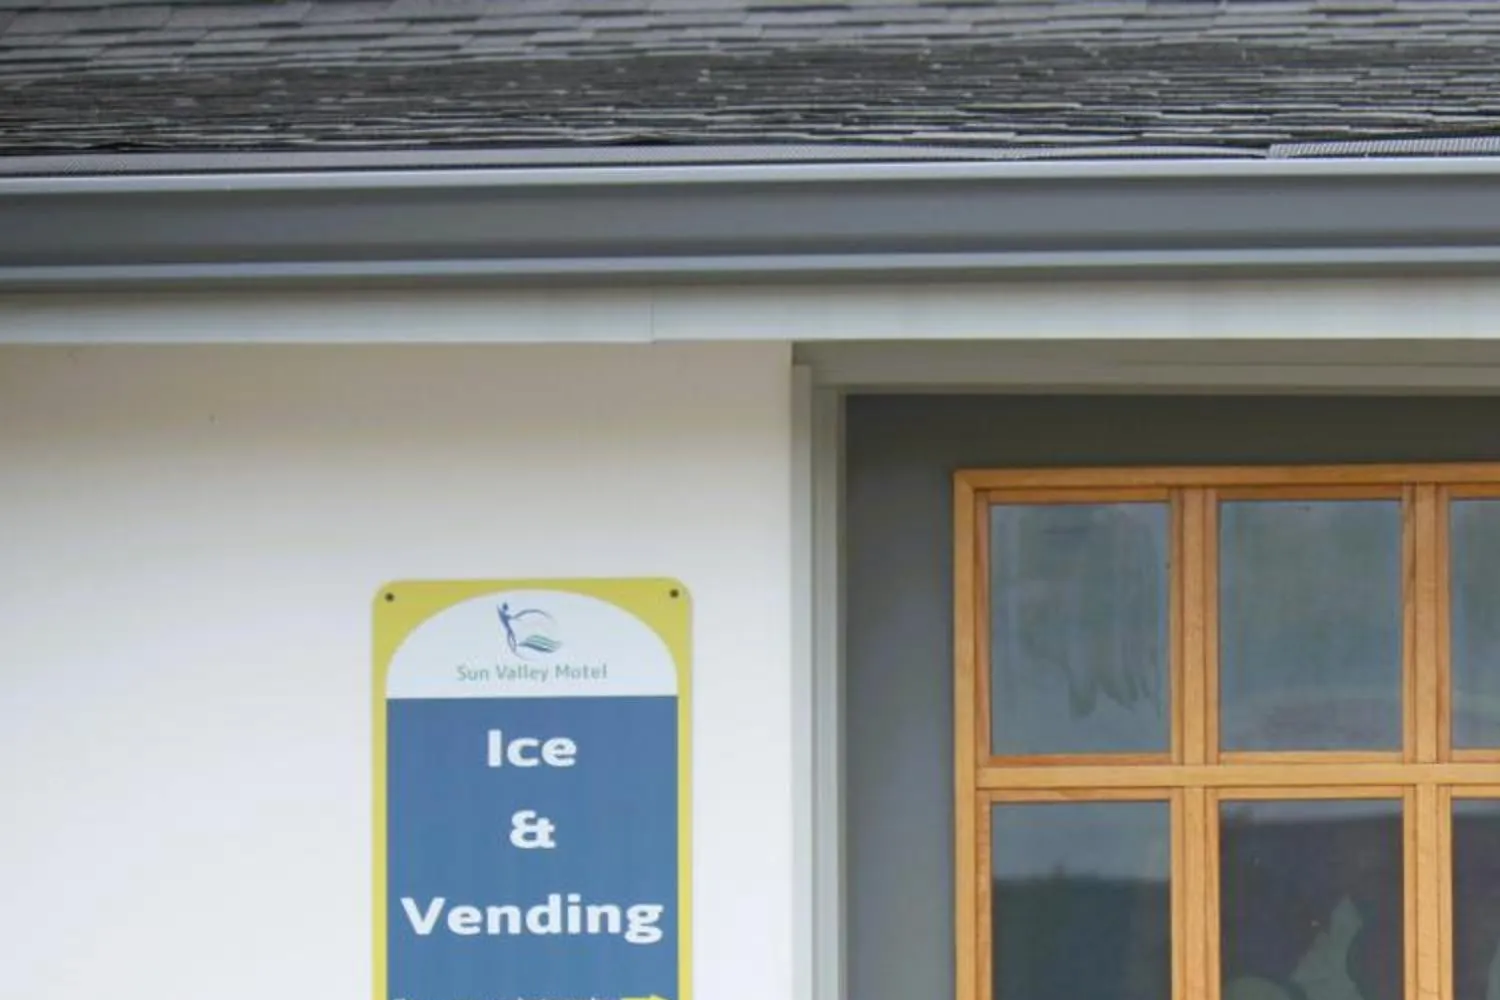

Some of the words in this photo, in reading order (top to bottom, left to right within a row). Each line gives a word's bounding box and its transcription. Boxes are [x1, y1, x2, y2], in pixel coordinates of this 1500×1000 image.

[456, 665, 490, 682] Sun
[496, 664, 549, 683] Valley
[555, 662, 608, 679] Motel
[487, 729, 577, 768] Ice
[509, 809, 557, 849] &
[400, 893, 665, 944] Vending
